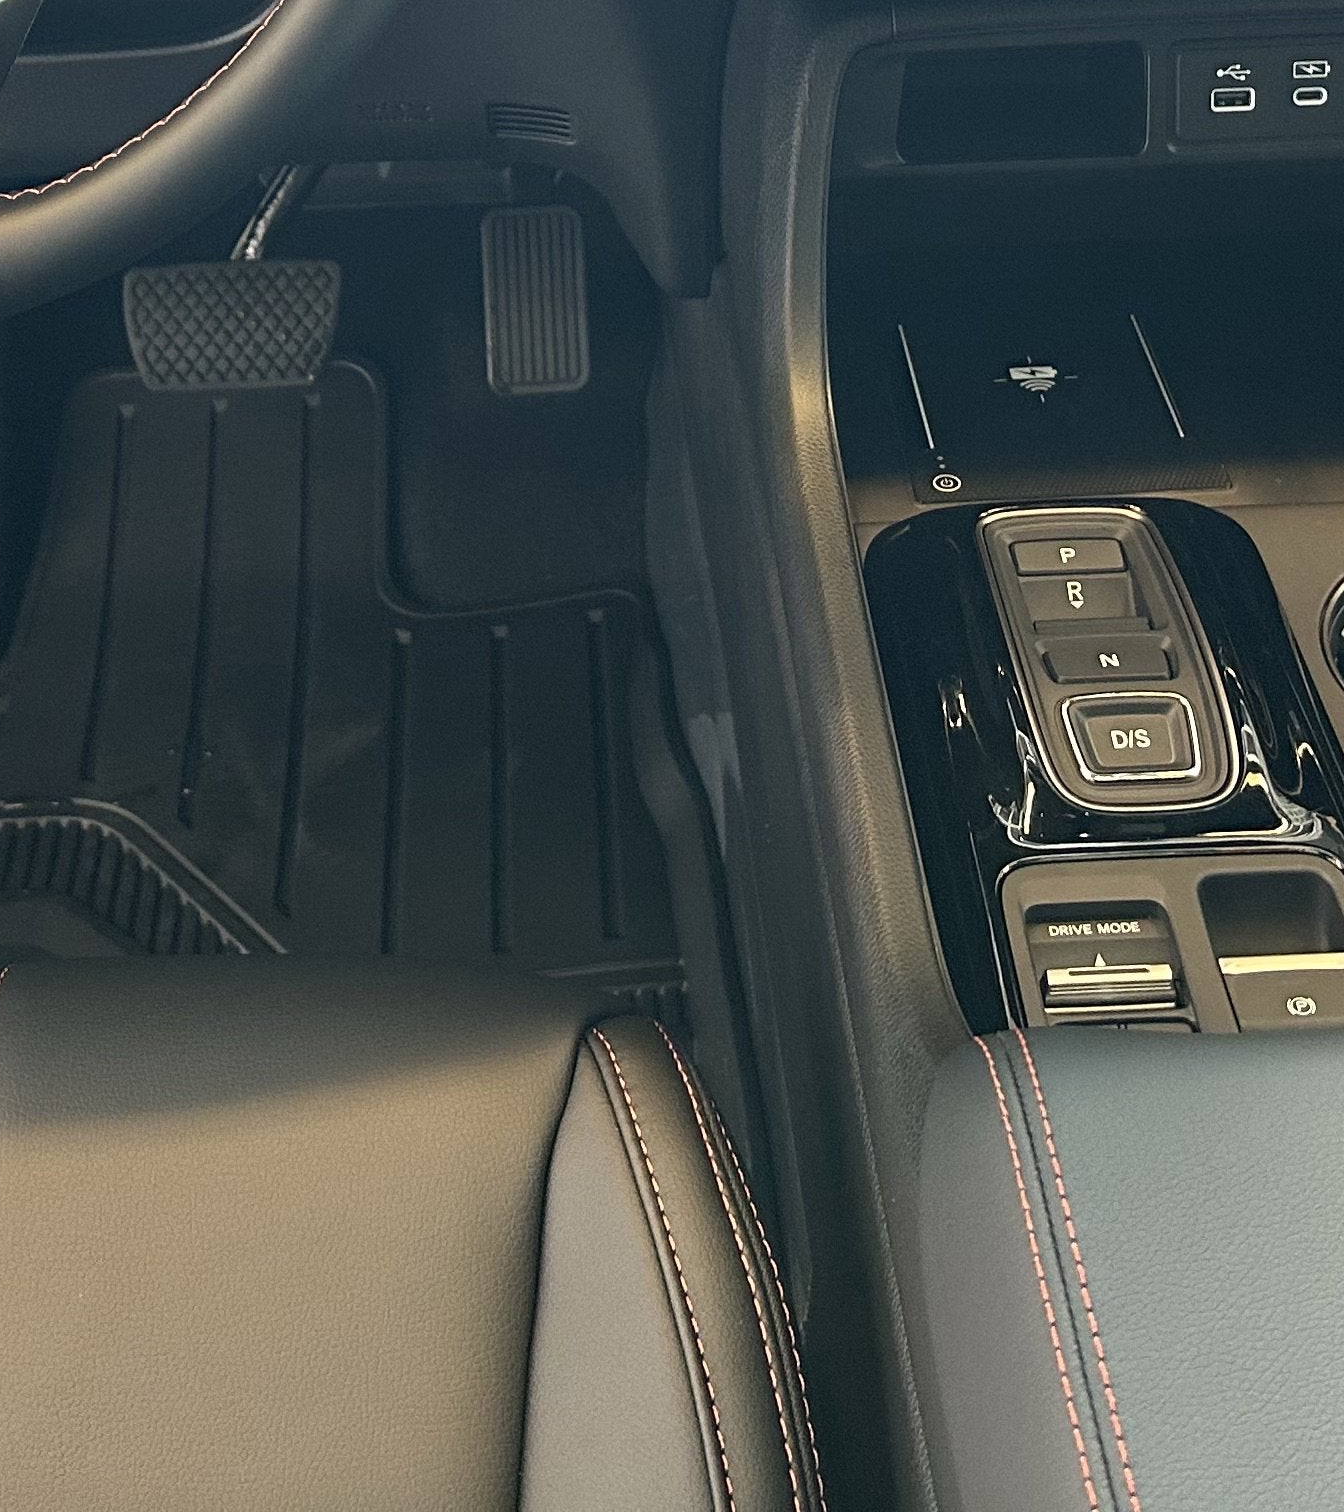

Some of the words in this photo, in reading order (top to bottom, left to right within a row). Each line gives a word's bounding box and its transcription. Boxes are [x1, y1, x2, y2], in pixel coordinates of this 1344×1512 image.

[1060, 547, 1076, 563] P
[1066, 581, 1084, 601] R
[1099, 652, 1120, 668] N
[1110, 728, 1152, 750] D/S
[1047, 923, 1093, 937] DRIVE
[1097, 921, 1141, 934] MODE
